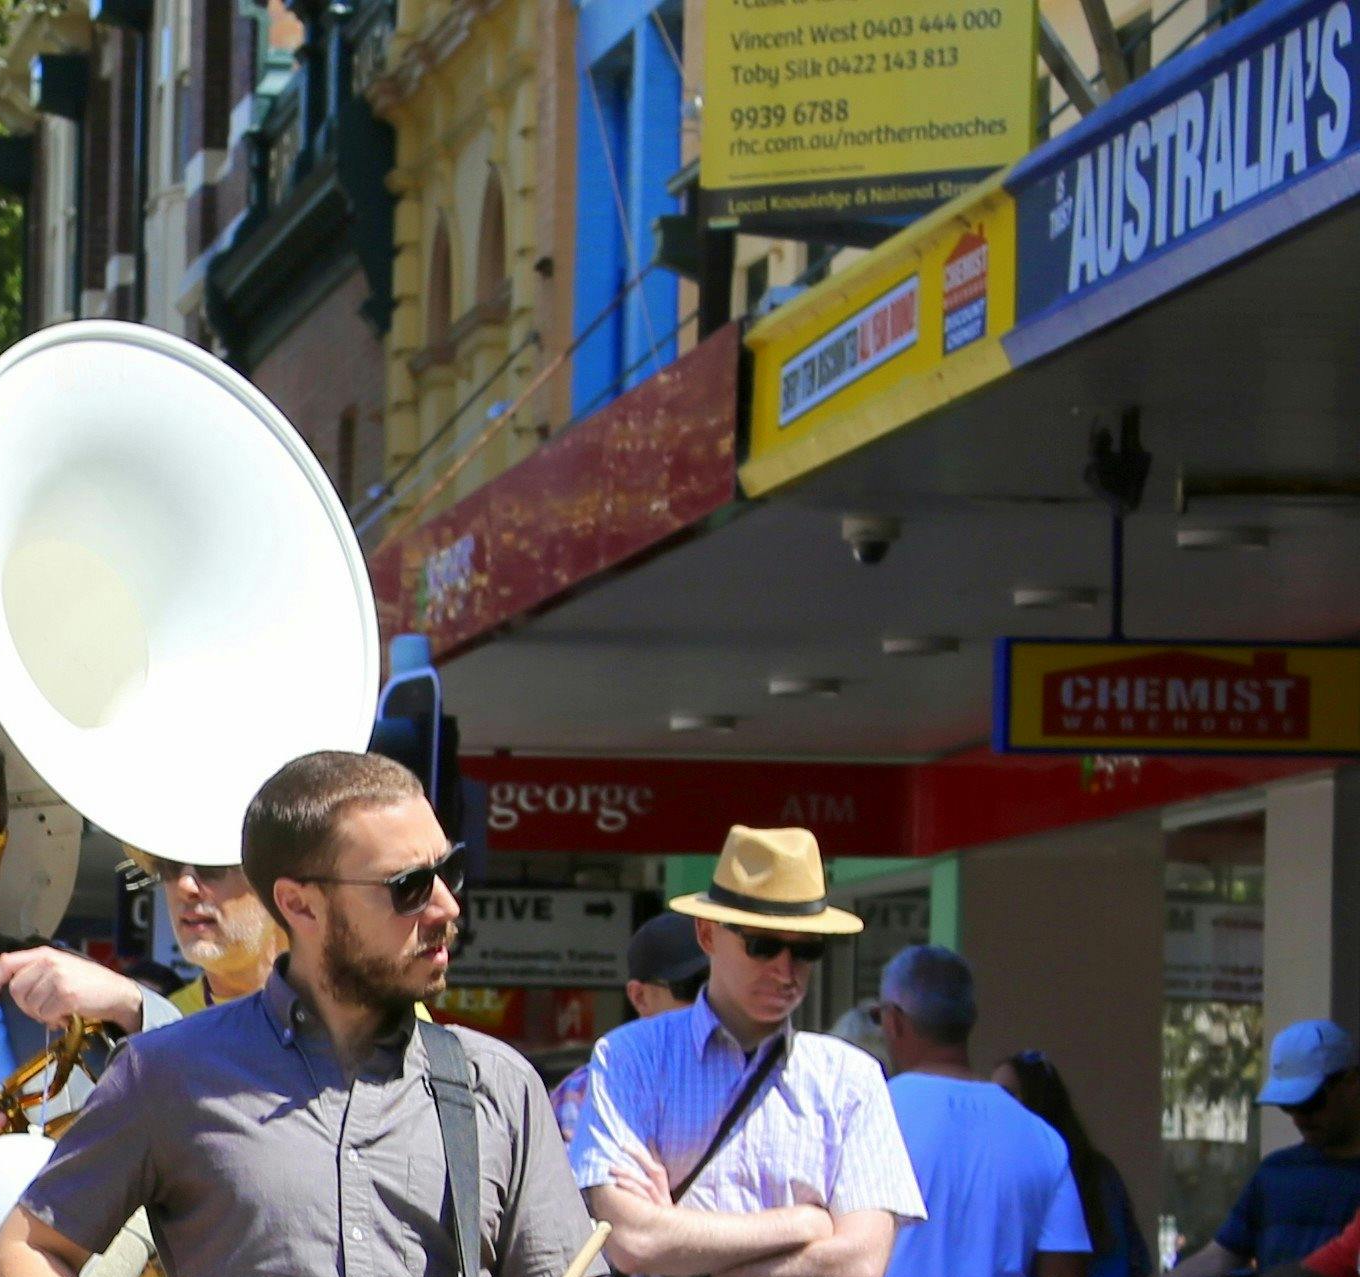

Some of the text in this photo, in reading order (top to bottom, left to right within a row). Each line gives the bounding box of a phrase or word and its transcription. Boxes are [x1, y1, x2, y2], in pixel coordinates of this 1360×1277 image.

[732, 8, 1002, 50] Vincent West 0403 444 000
[731, 47, 958, 87] Toby Silk 0422 143 813
[731, 98, 848, 131] 9939 6788
[729, 116, 1007, 157] rhc.com.au/northernbeaches
[1068, 1, 1352, 294] AUSTRALIA'S
[1060, 676, 1296, 713] CHEMIST
[487, 781, 654, 832] george
[780, 794, 855, 823] ATM
[473, 896, 554, 921] TIVE
